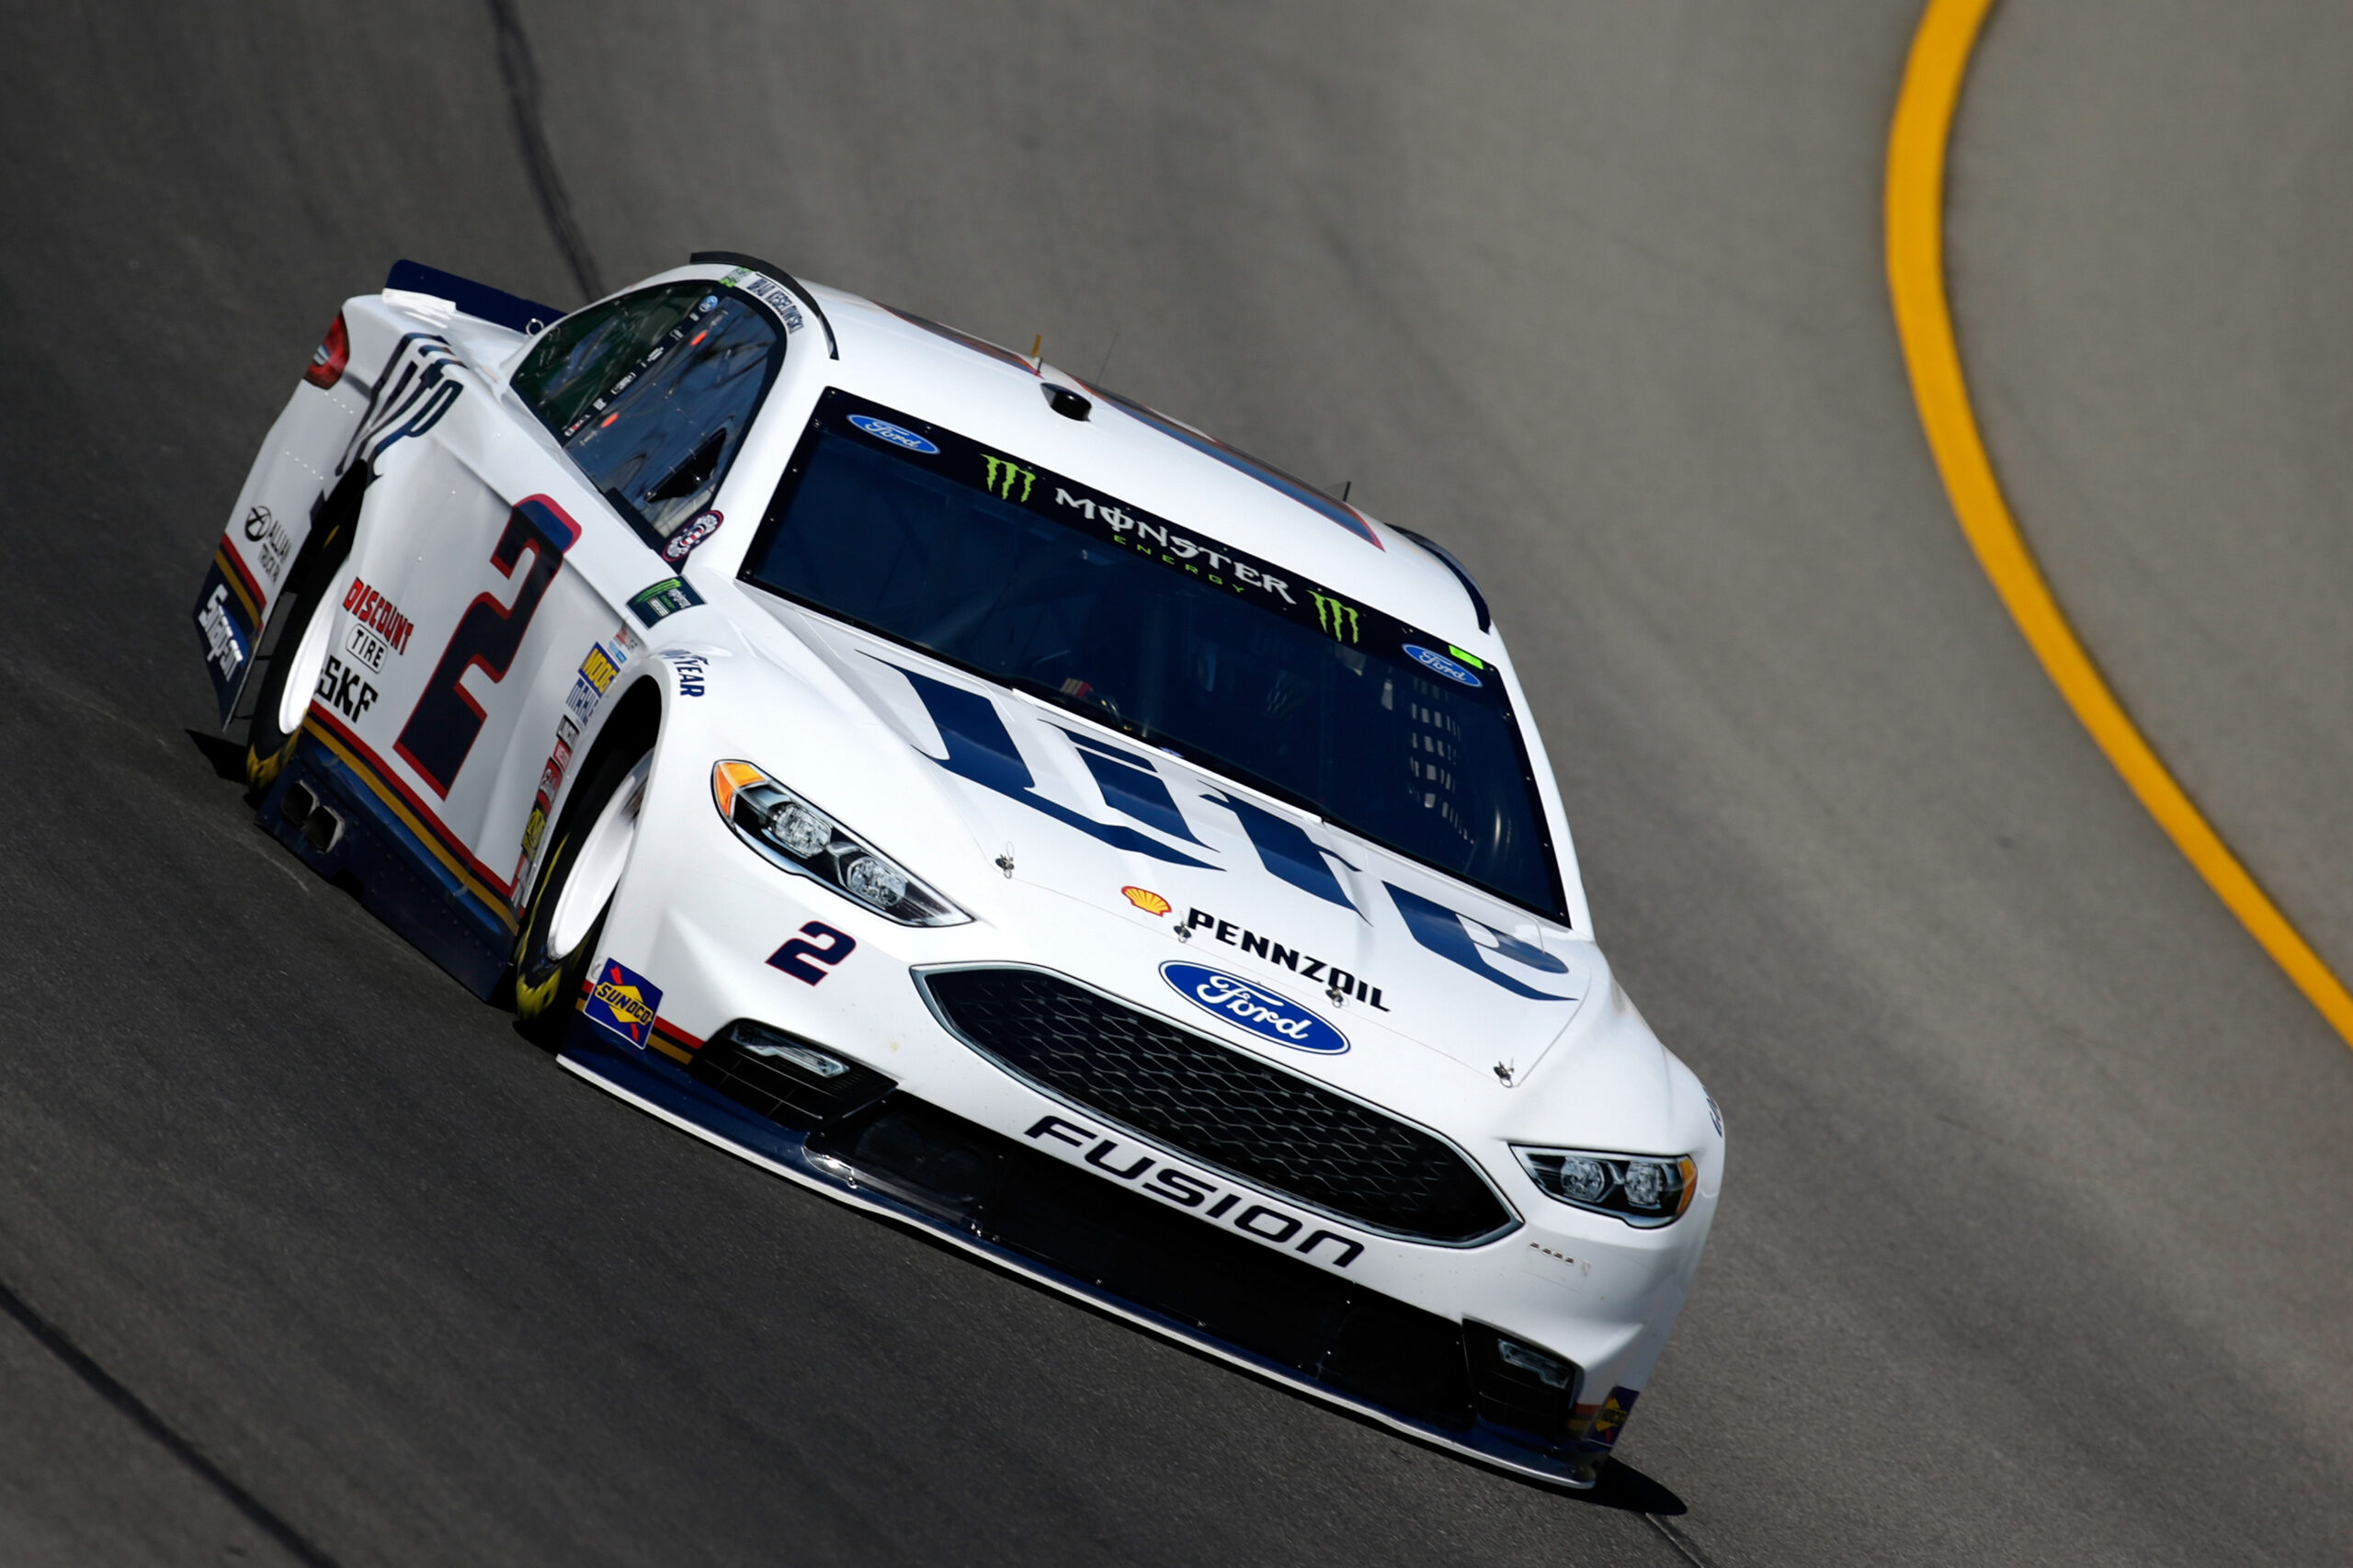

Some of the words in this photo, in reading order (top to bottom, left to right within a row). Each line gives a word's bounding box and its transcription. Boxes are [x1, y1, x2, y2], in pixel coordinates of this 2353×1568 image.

[865, 421, 922, 449] Ford
[1055, 488, 1297, 605] MONSTER
[1113, 534, 1245, 593] ENERGY
[343, 576, 415, 655] DISCOUNT
[392, 493, 582, 801] 2
[350, 629, 384, 669] TIRE
[582, 647, 619, 694] MOOG
[1418, 651, 1466, 681] Ford
[314, 655, 378, 723] SKF
[765, 920, 857, 987] 2
[1187, 907, 1391, 1012] PENNZOIL
[597, 983, 653, 1024] SUNOCO
[1197, 975, 1313, 1040] Ford
[1024, 1115, 1365, 1267] FUSION
